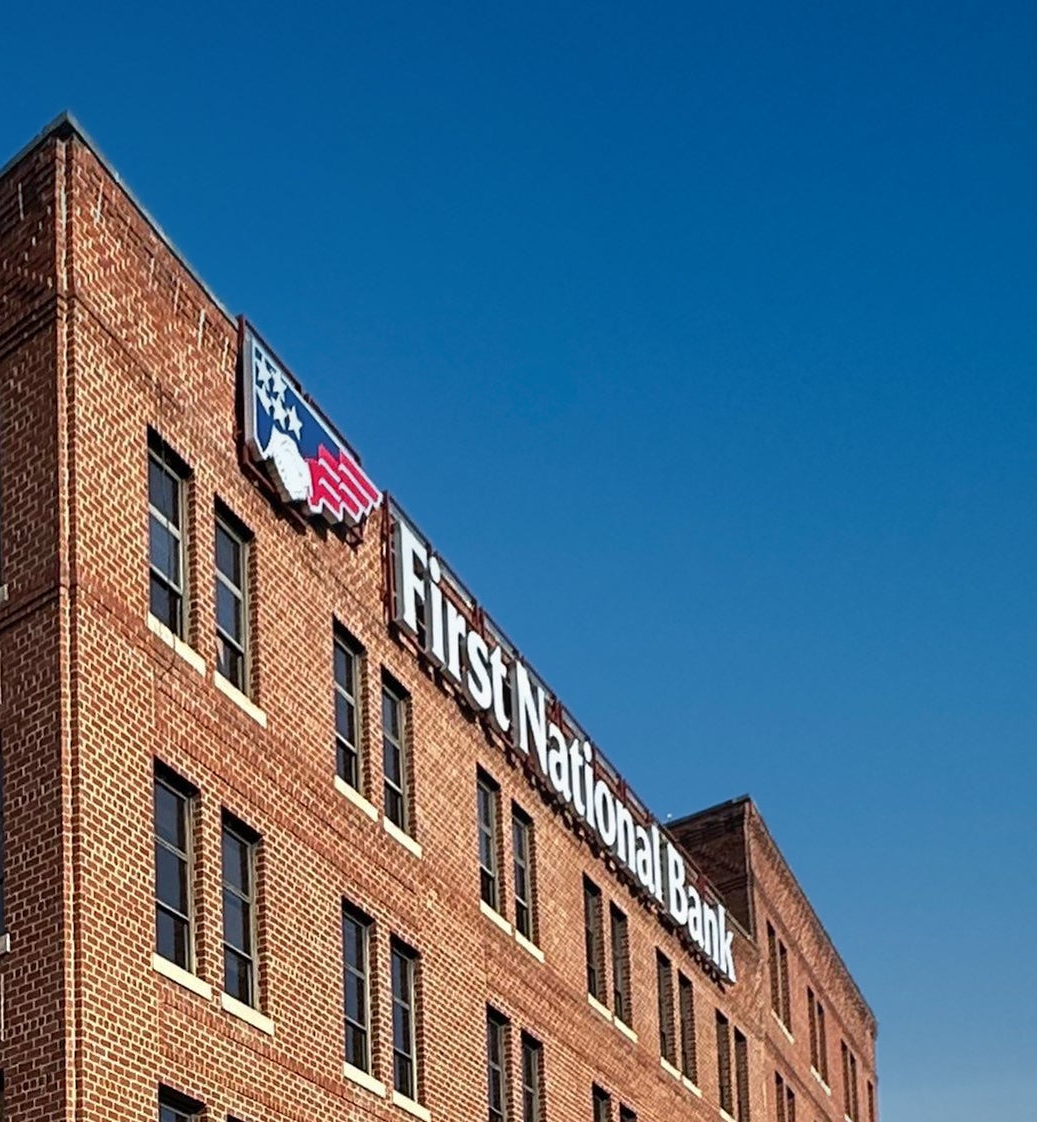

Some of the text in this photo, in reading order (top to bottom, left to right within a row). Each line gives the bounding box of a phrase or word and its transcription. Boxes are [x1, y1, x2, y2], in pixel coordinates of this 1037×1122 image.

[394, 518, 737, 984] First National Bank
